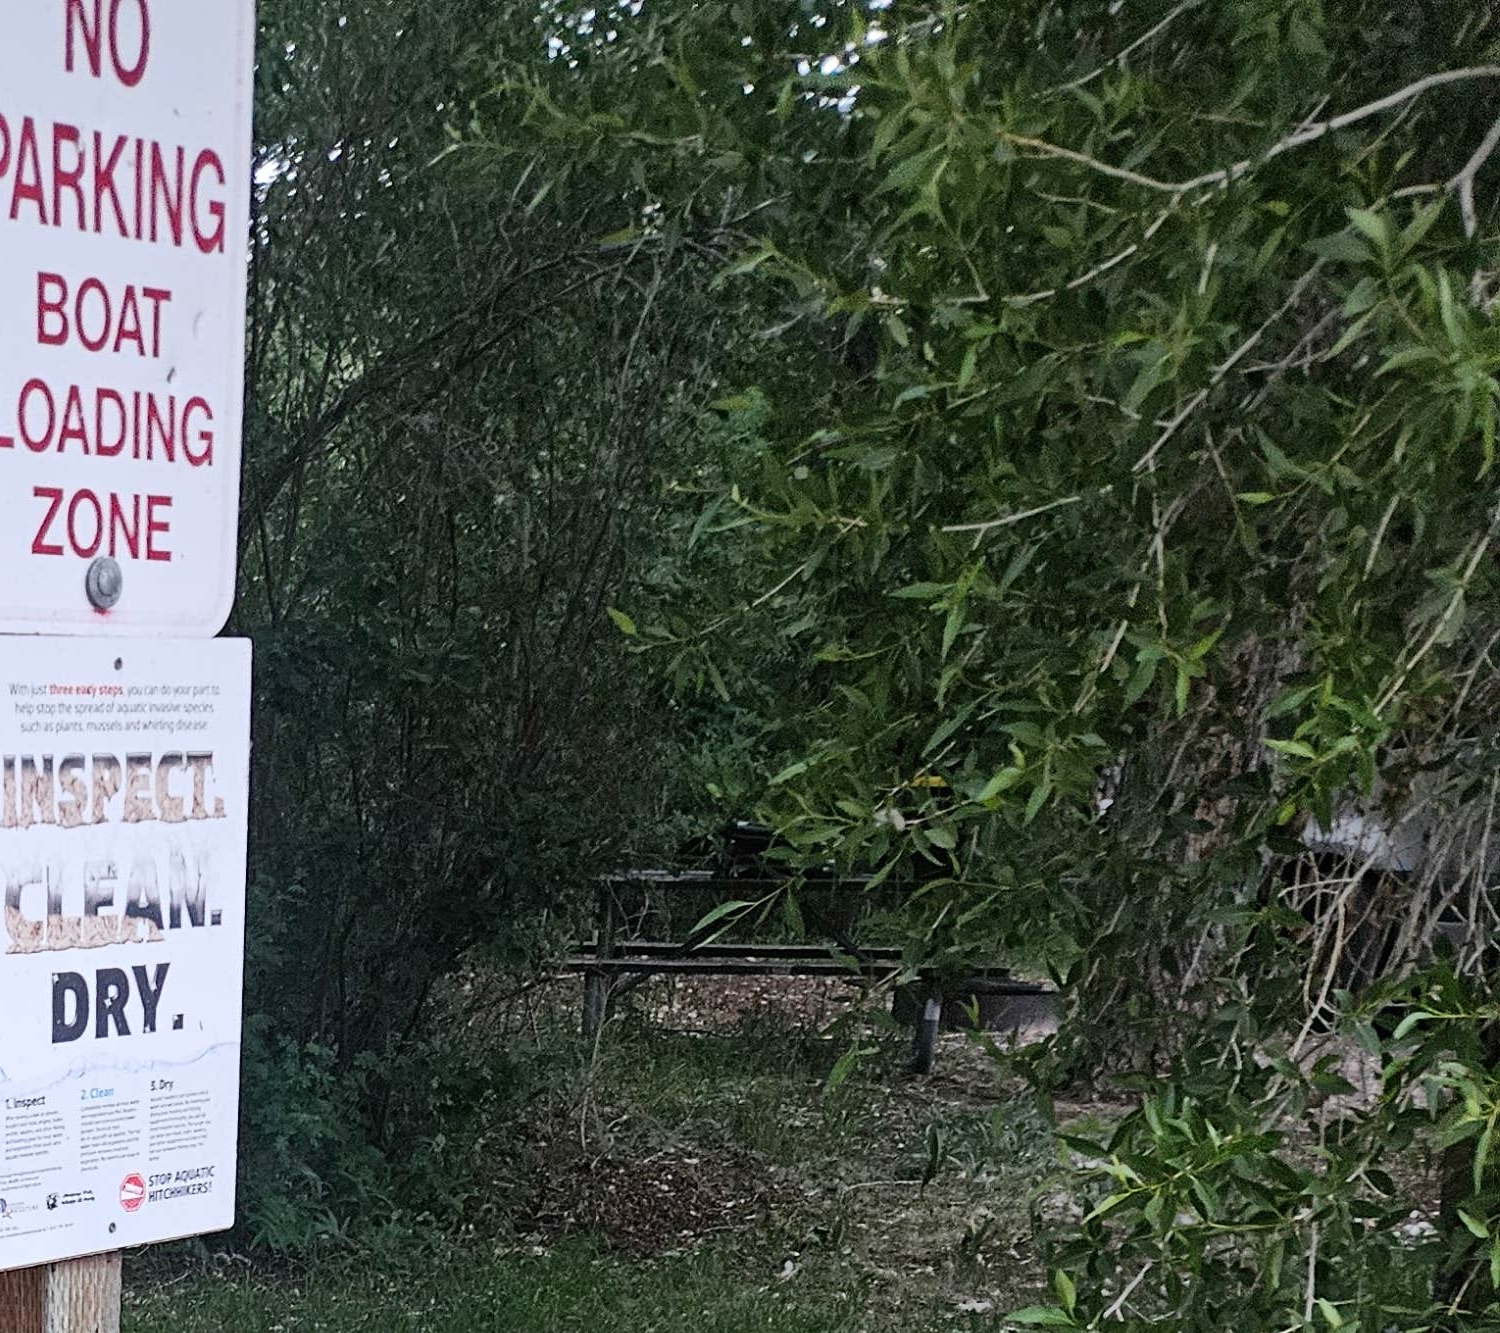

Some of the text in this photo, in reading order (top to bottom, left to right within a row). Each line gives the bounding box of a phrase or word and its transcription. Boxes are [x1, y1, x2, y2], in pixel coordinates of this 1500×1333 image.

[64, 0, 151, 87] NO
[36, 271, 173, 359] BOAT
[31, 485, 174, 562] ZONE
[8, 683, 29, 696] With
[30, 683, 47, 698] just
[49, 683, 74, 696] three
[75, 685, 97, 699] easy
[126, 685, 143, 698] you
[144, 685, 159, 696] can
[160, 683, 171, 696] do
[172, 685, 190, 698] your
[192, 685, 211, 698] part
[211, 685, 220, 696] to
[14, 700, 215, 716] help stop the spread of aquatic invasive species
[20, 718, 41, 732] such
[43, 720, 54, 732] as
[86, 718, 122, 732] mussels
[124, 717, 141, 731] and
[142, 716, 175, 733] whirling
[0, 751, 227, 829] INSPECT.
[1, 850, 223, 955] CLEAN.
[51, 962, 184, 1044] DRY.
[90, 1087, 114, 1100] Clean
[159, 1079, 174, 1093] Dry
[14, 1095, 46, 1109] Inspect
[148, 1165, 215, 1188] STOP AQUATIC
